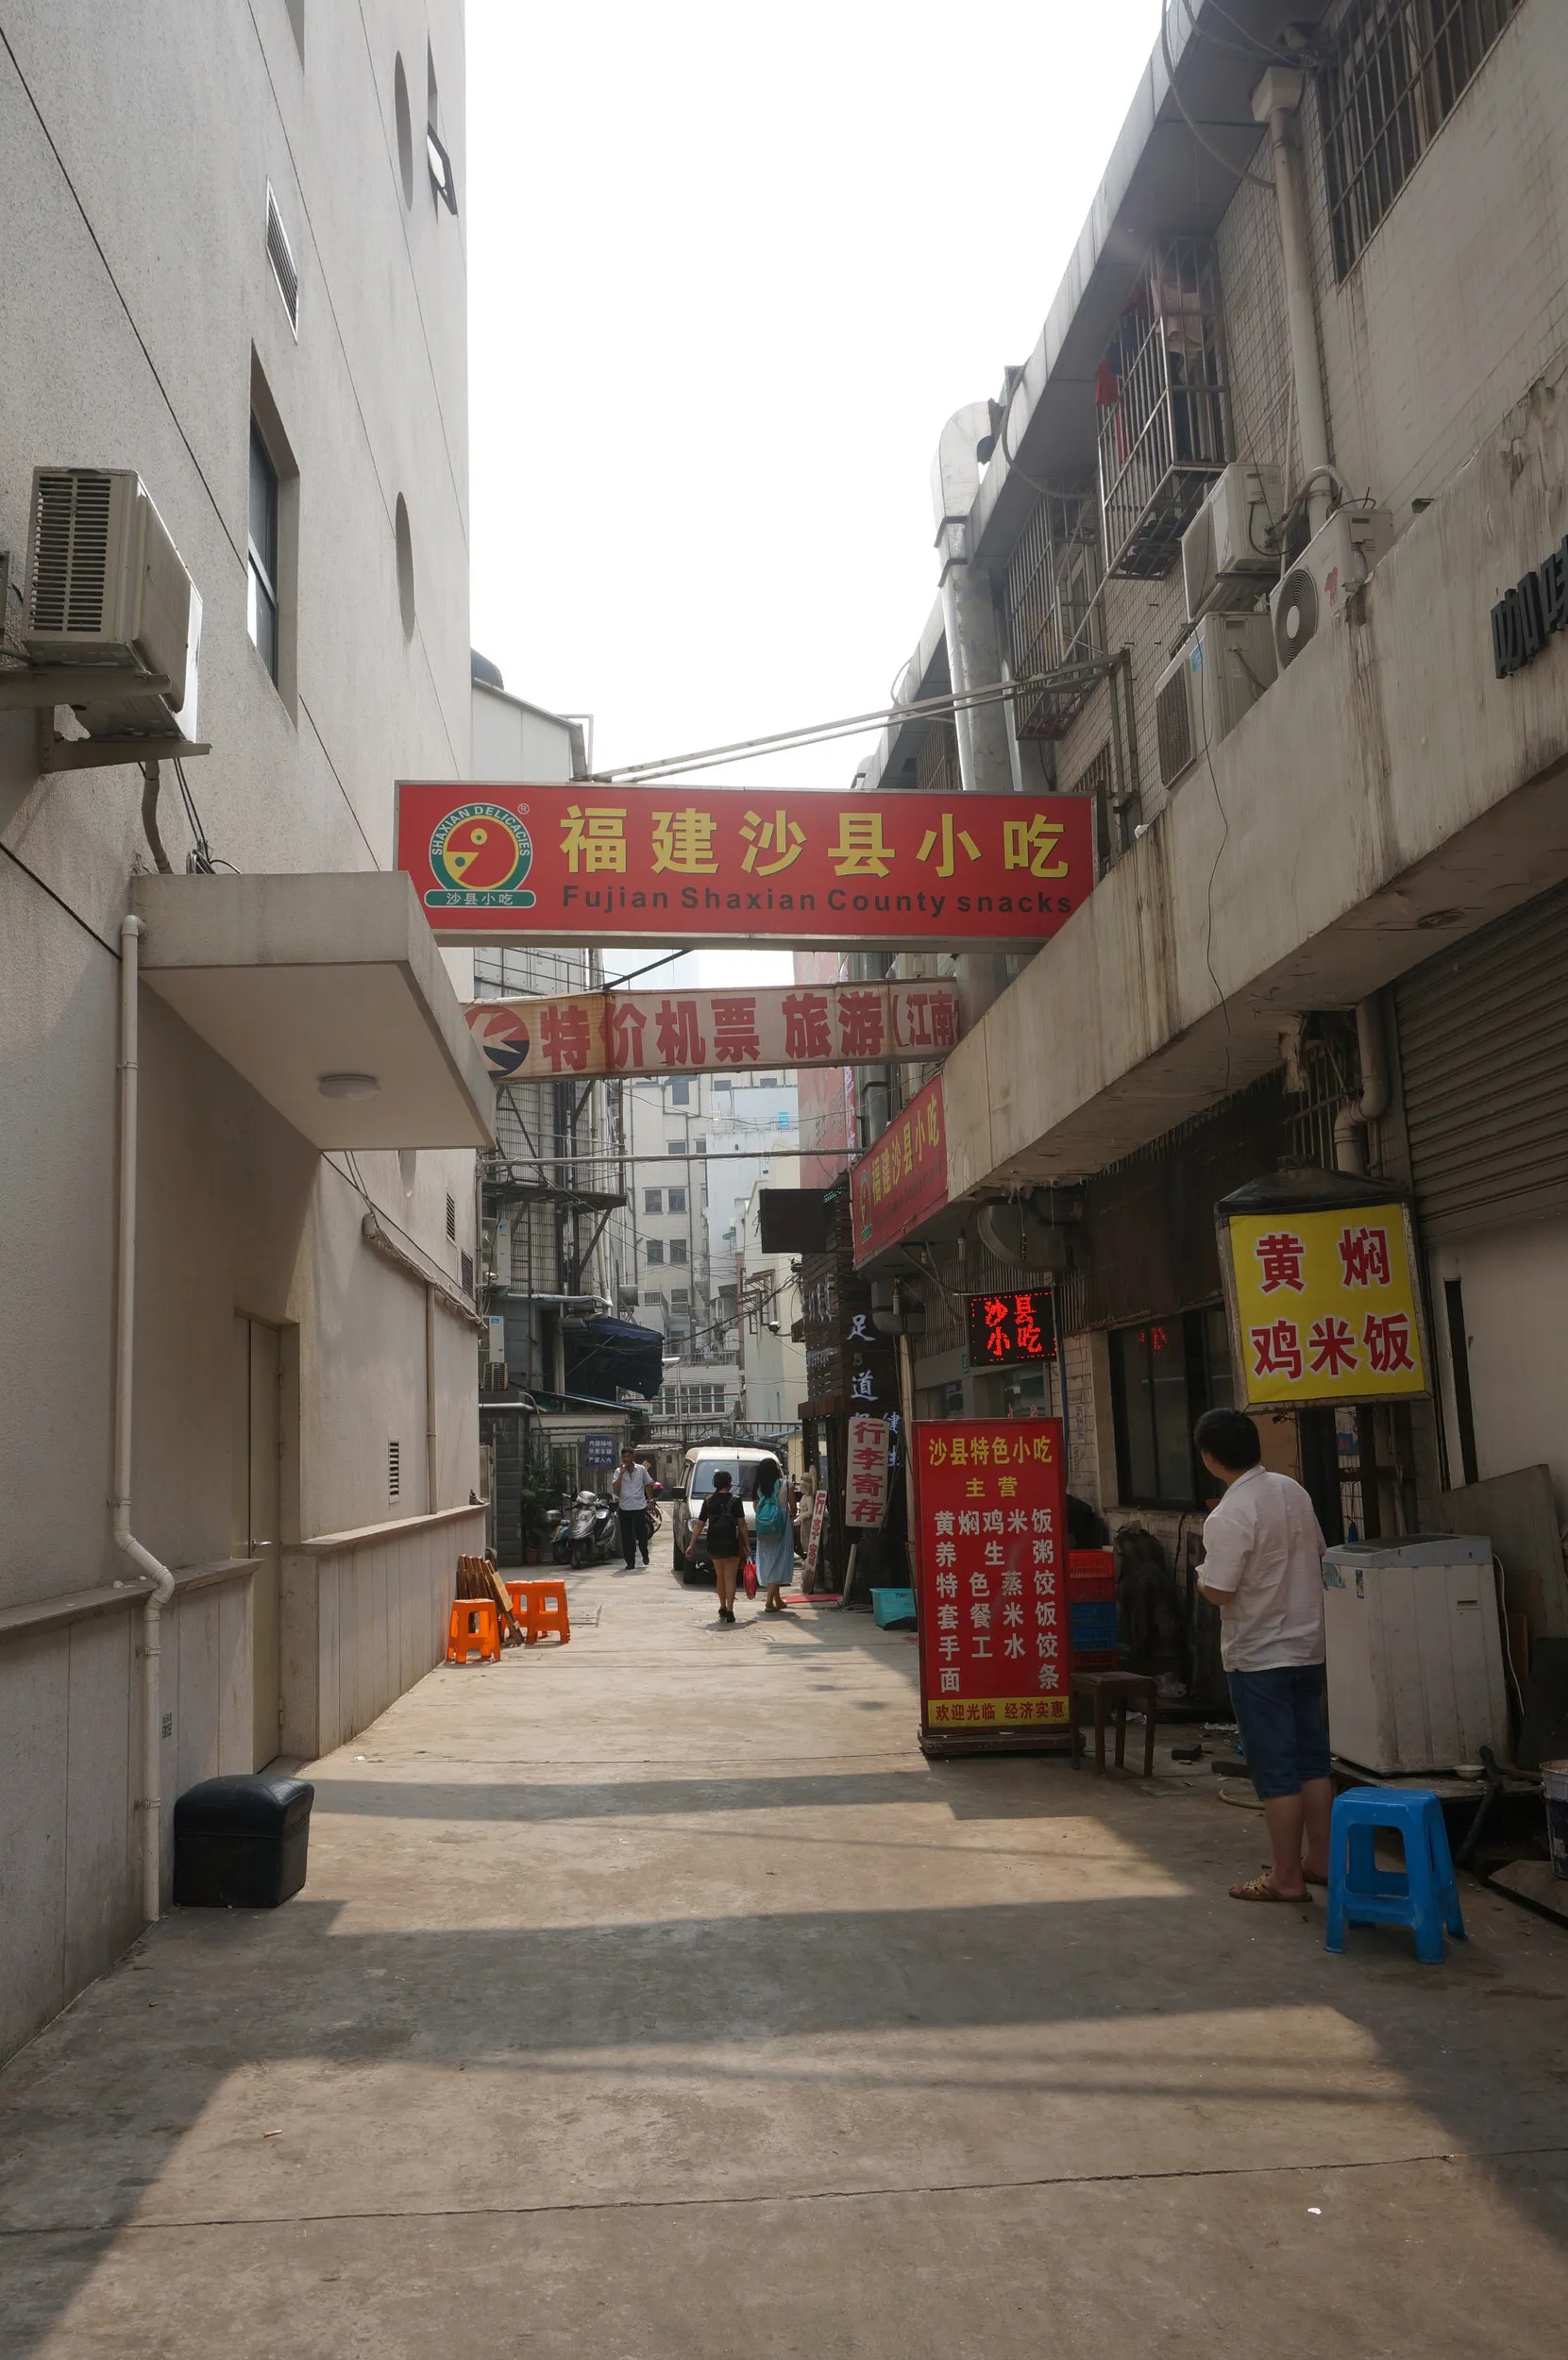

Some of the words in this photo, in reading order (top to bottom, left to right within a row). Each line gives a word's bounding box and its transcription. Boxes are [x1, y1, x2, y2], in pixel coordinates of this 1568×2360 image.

[431, 807, 471, 855] SHAXIAN
[474, 805, 531, 857] DELICACIES
[560, 804, 1071, 880] 福建沙县小吃
[446, 891, 514, 906] 沙县小吃
[563, 885, 668, 911] Fujian
[681, 887, 816, 911] Shaxian
[828, 889, 945, 917] County
[956, 891, 1072, 914] snacks
[540, 998, 760, 1073] 特价机票
[871, 1093, 940, 1206] 福建沙县小吃
[1256, 1228, 1391, 1293] 黄焖
[985, 1295, 1037, 1327] 沙县
[986, 1325, 1042, 1356] 小吃
[1251, 1312, 1415, 1379] 鸡米饭
[928, 1435, 1053, 1466] 沙县特色小吃
[850, 1420, 886, 1524] 行李寄存
[966, 1475, 1018, 1497] 主营
[934, 1508, 1054, 1537] 黄焖鸡米饭
[936, 1539, 1054, 1568] 养生粥
[936, 1569, 1056, 1598] 特色蒸饺
[937, 1601, 1057, 1630] 套餐米饭
[938, 1631, 1058, 1661] 手工水饺
[939, 1663, 1060, 1693] 面条
[936, 1702, 996, 1722] 欢迎光临
[1004, 1699, 1065, 1719] 经济实惠
